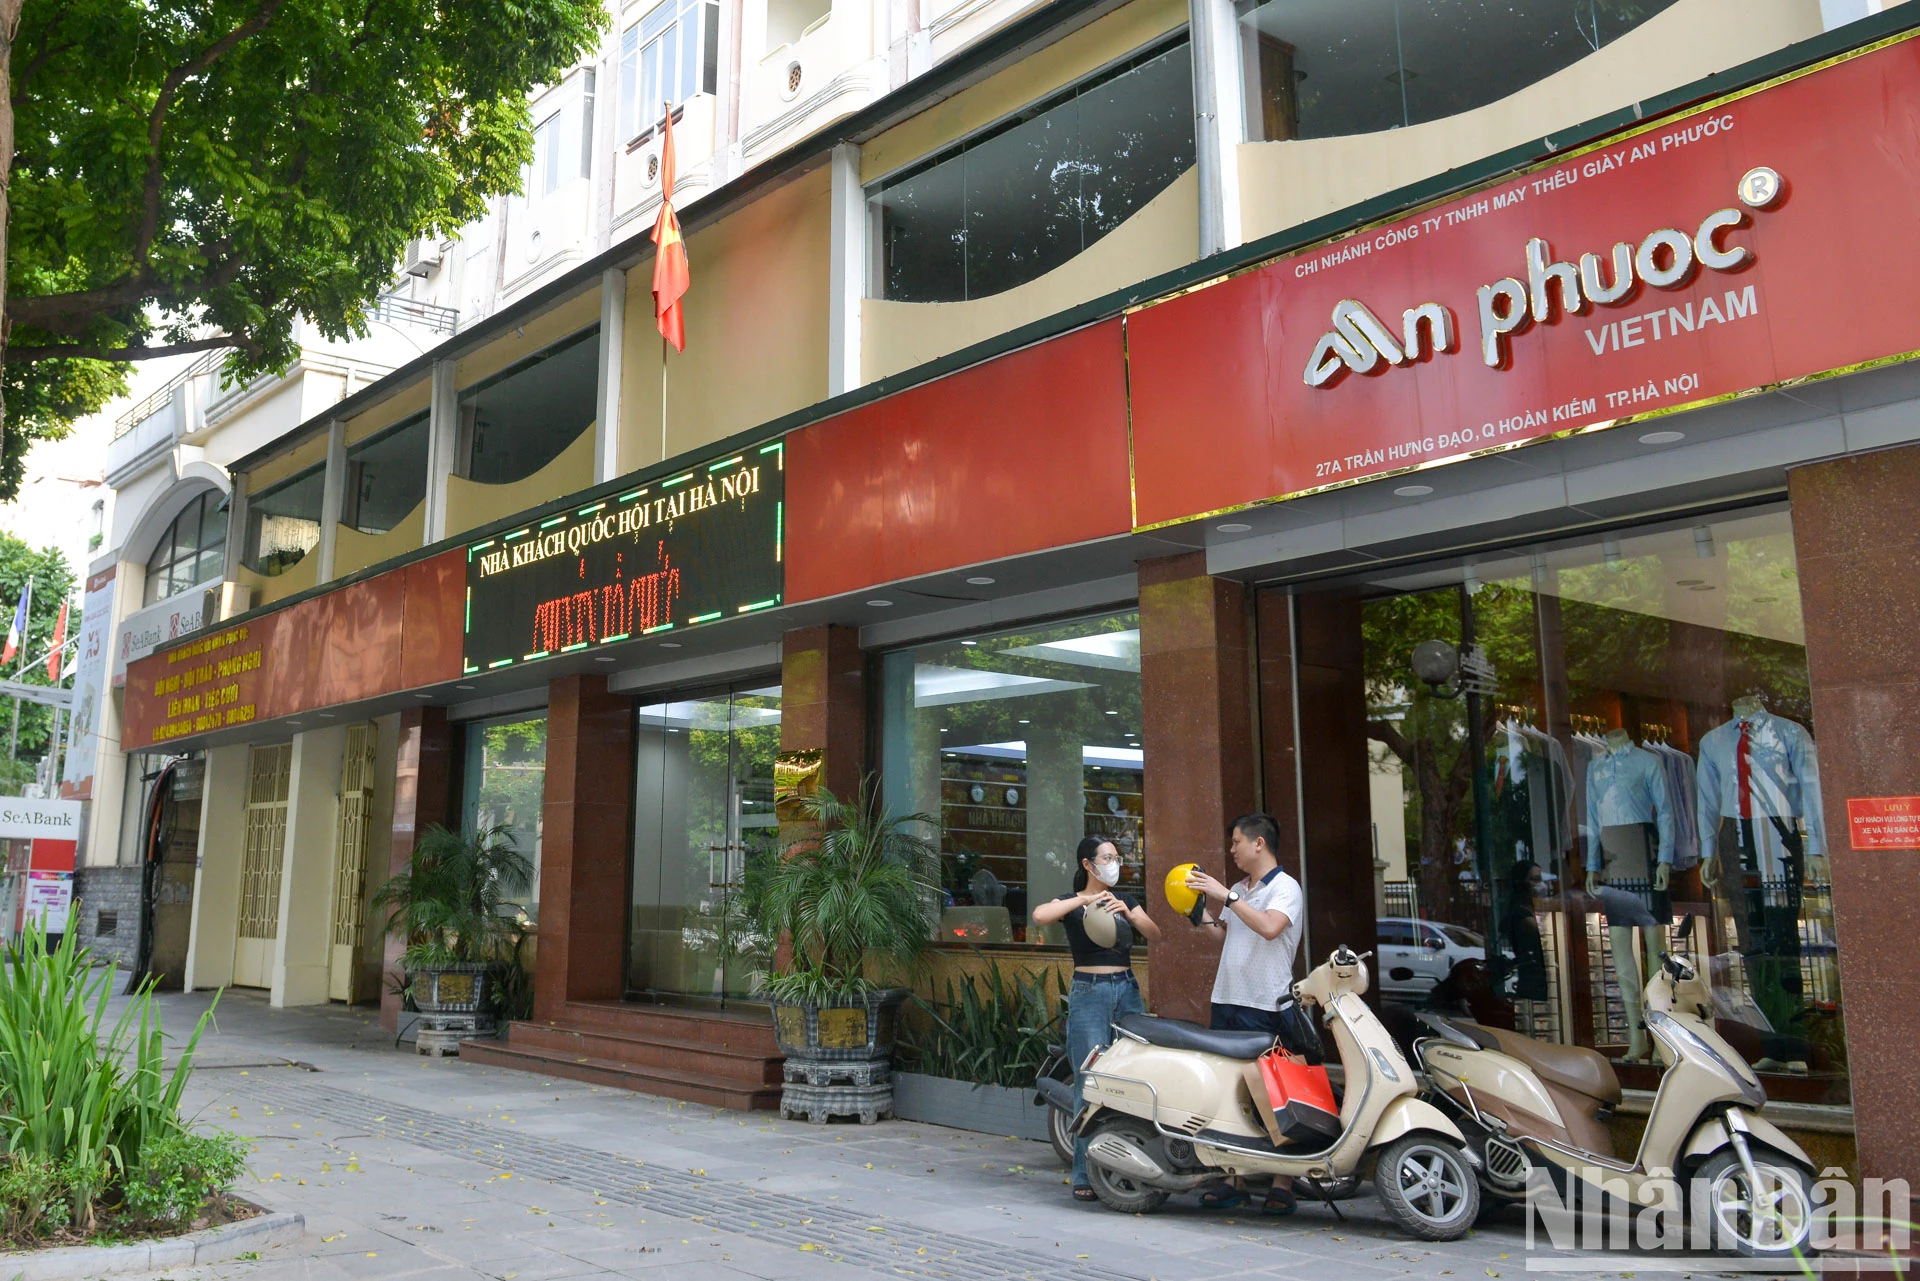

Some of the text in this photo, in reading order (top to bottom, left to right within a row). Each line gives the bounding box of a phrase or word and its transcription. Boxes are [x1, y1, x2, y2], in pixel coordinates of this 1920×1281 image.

[1295, 114, 1735, 279] CHI NHÁNH CÔNG TY TNHH MAY THÊU GIÀY AN PHƯỚC
[1476, 207, 1750, 369] phuoc
[1584, 285, 1759, 357] VIETNAM
[1315, 460, 1342, 477] 27A
[1344, 447, 1385, 470] TRẦN
[1389, 436, 1434, 460] HƯNG
[1482, 423, 1495, 438] Q
[1500, 408, 1548, 435] HOÀN
[1553, 397, 1597, 422] KIẾM
[1664, 373, 1699, 396] NỘI
[480, 466, 760, 578] NHÀ KHÁCH QUỐC HỘI TẠI HÀ NỘI
[2, 810, 73, 827] SeABank
